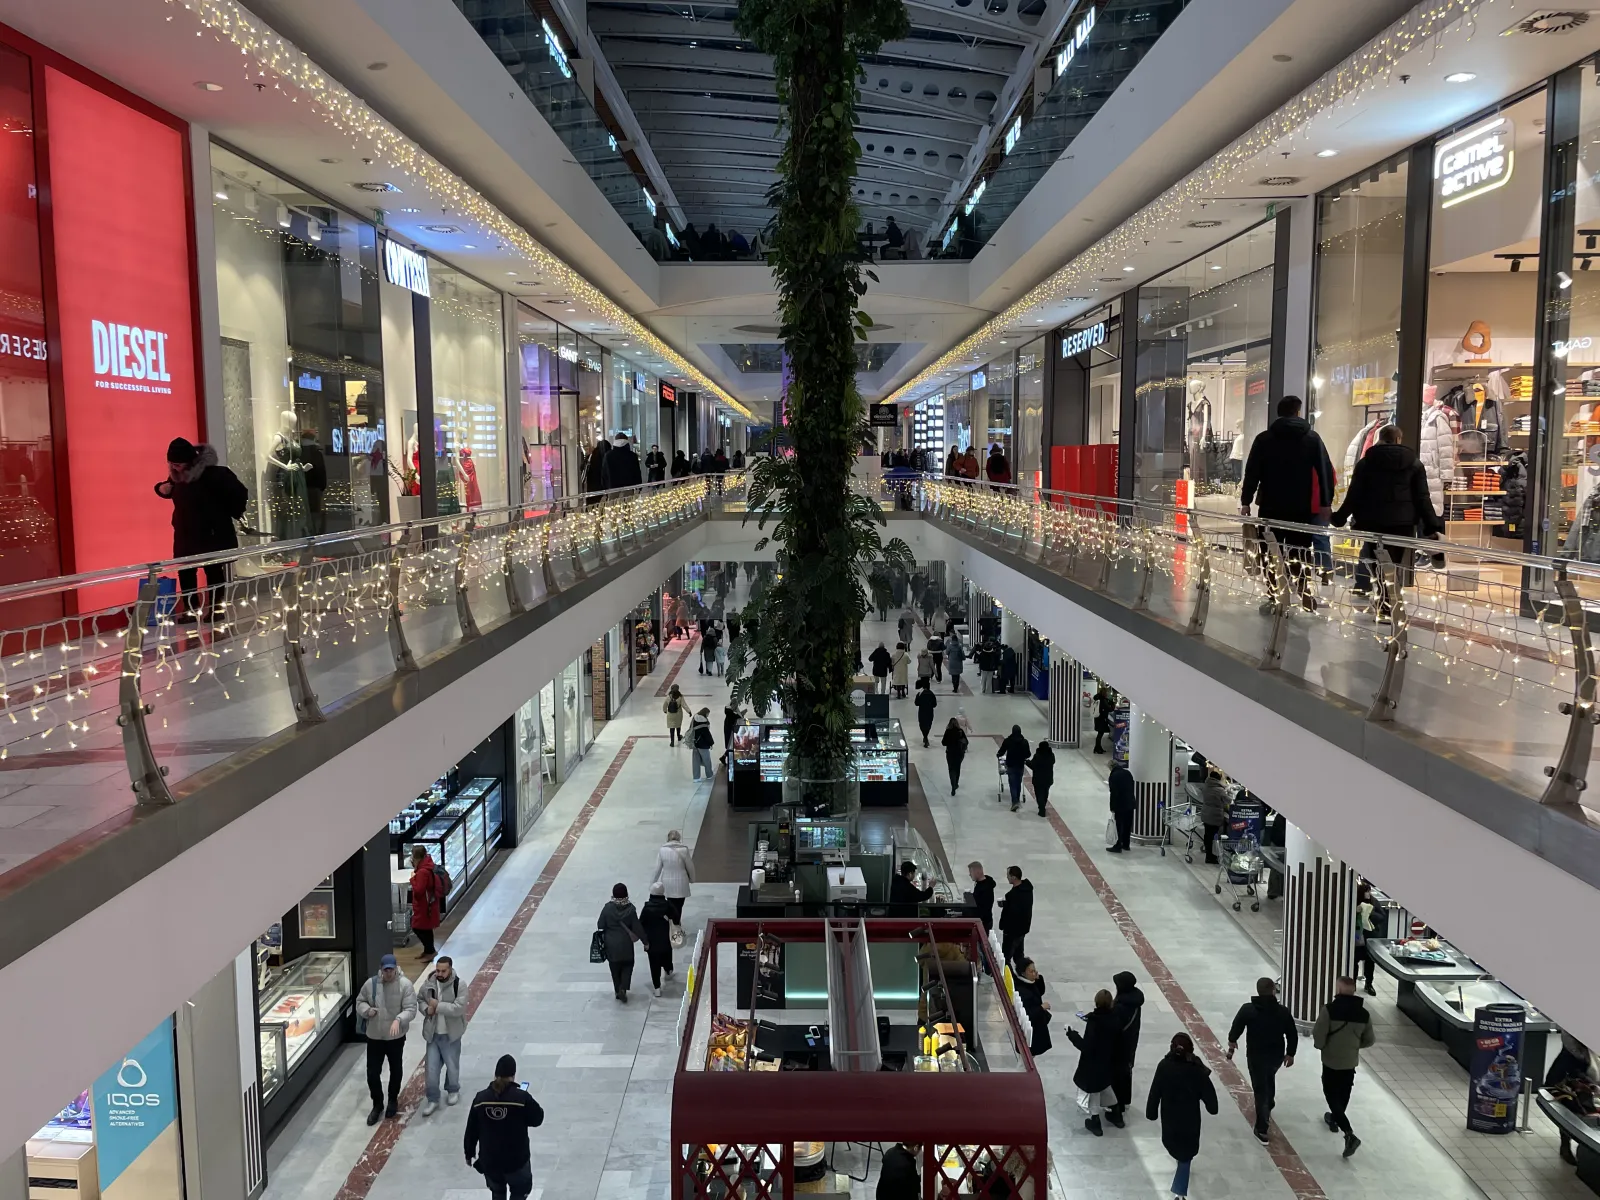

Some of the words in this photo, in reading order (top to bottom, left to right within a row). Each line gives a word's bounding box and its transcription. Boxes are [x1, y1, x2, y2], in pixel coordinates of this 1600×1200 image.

[1442, 135, 1504, 175] camel
[91, 319, 171, 382] DIESEL
[1062, 322, 1105, 359] RESERVED
[95, 380, 109, 389] FOR
[111, 382, 151, 393] SUCCESSFUL
[152, 386, 172, 395] LIVING
[107, 1093, 160, 1108] IQOS
